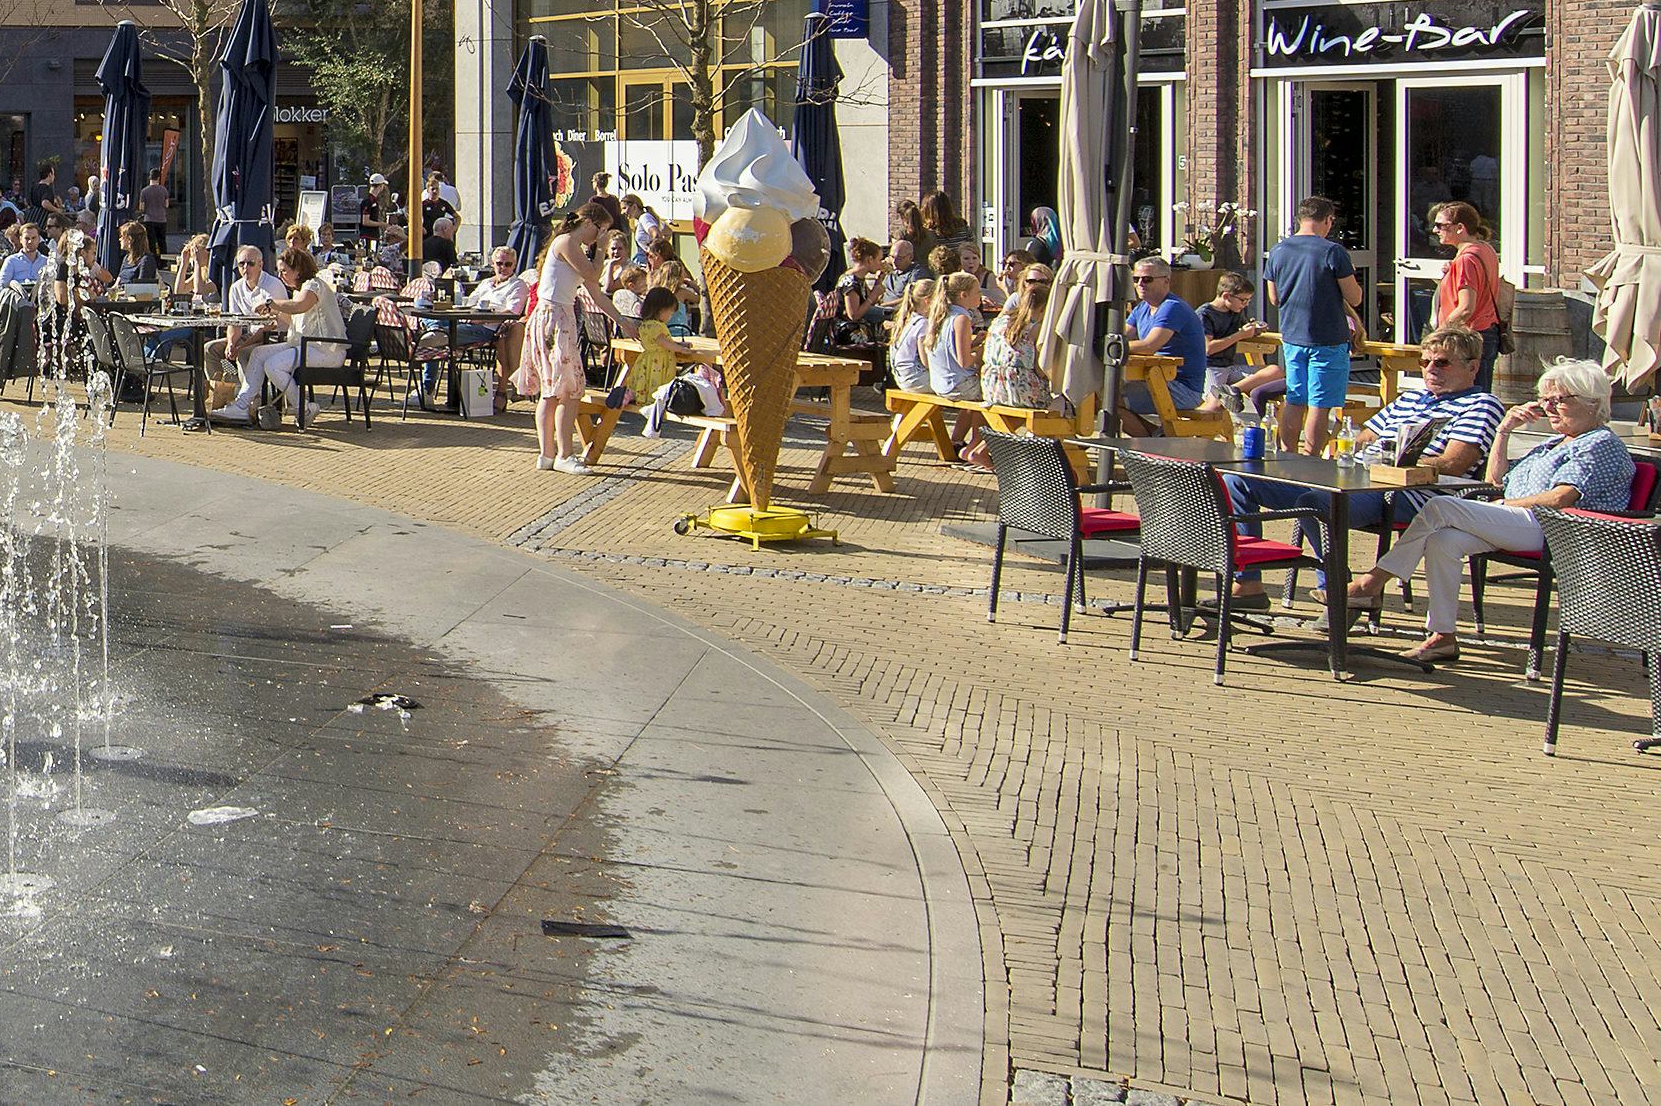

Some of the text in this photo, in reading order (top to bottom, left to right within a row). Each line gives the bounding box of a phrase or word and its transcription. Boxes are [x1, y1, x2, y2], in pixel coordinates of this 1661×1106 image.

[1267, 9, 1529, 57] Wine-Bar
[273, 106, 328, 122] lokker
[567, 129, 586, 141] Diner
[595, 129, 617, 141] Borrel
[618, 162, 660, 192] Solo
